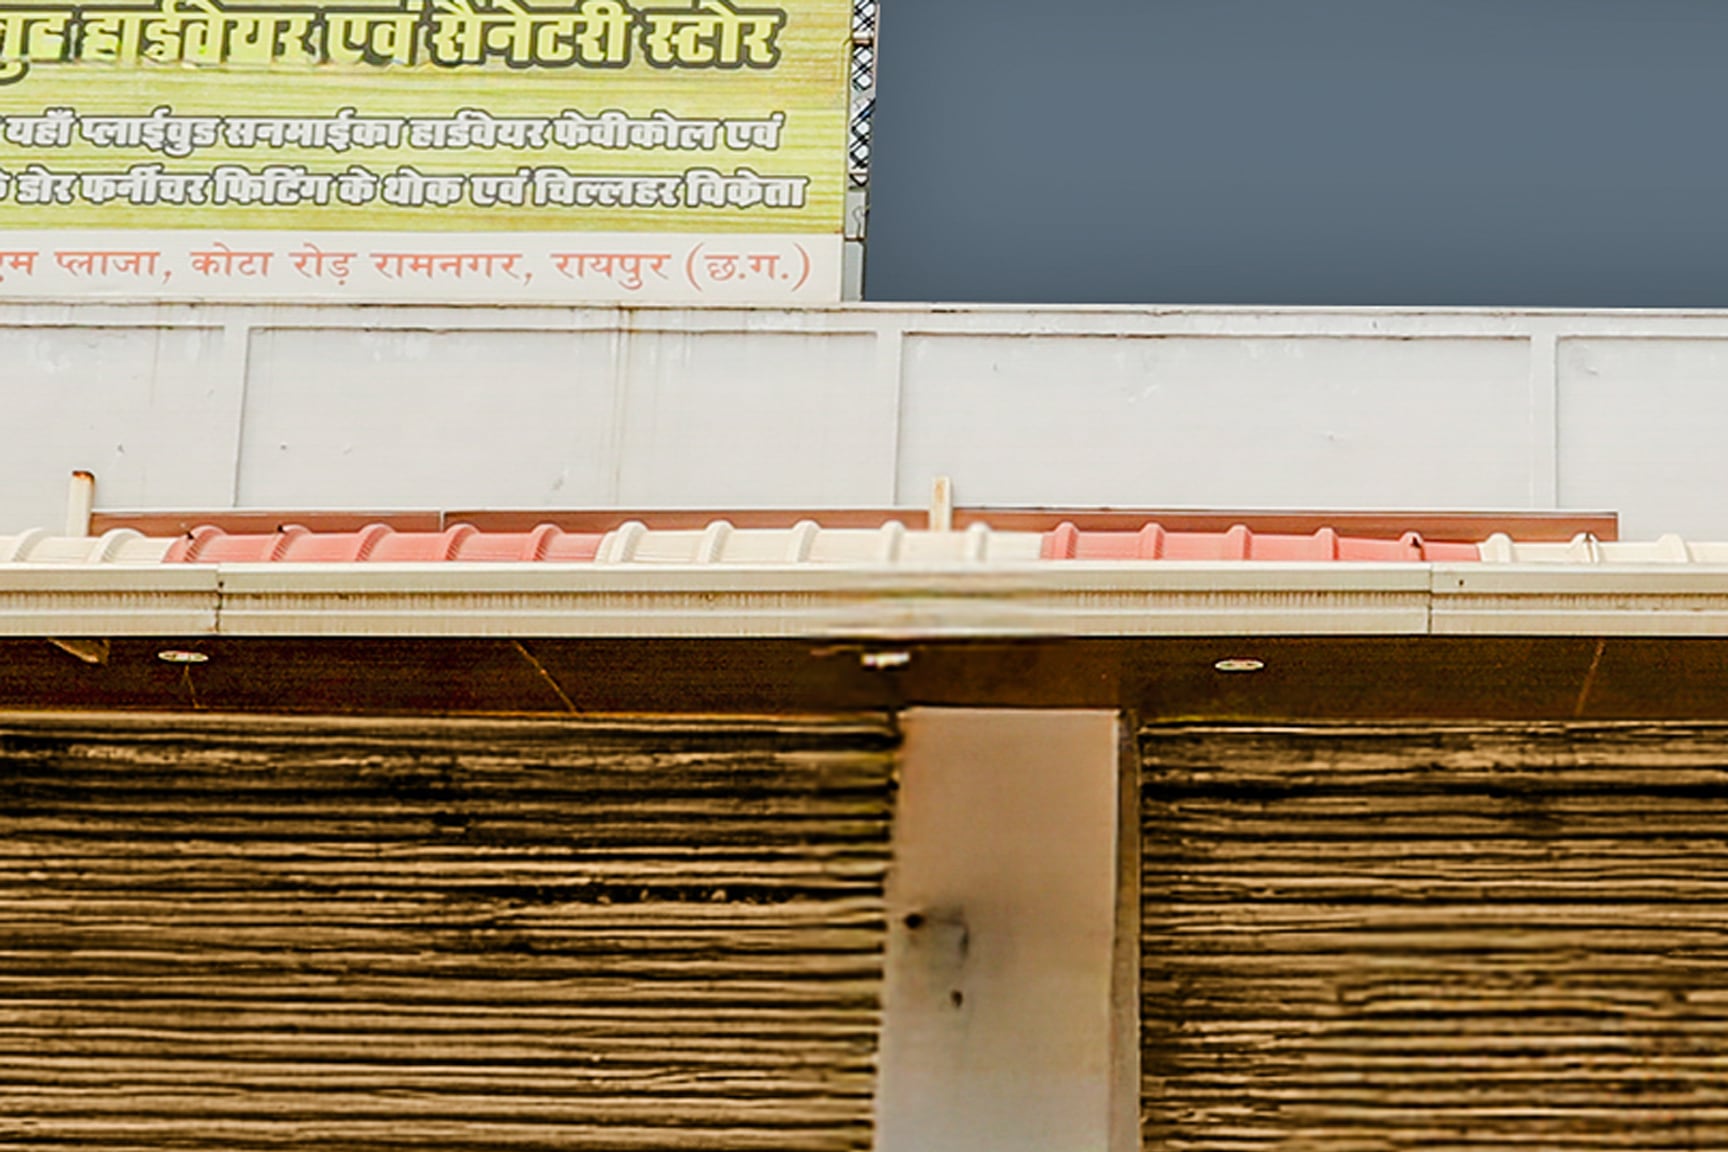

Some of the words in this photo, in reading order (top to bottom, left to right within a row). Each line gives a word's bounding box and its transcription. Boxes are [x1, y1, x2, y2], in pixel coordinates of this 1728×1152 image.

[640, 0, 787, 70] स्टोर
[3, 107, 78, 148] यहाँ
[80, 105, 222, 158] प्लाईवुड
[222, 107, 405, 153] सनमाईका
[552, 108, 721, 150] फेवीकोल
[722, 111, 786, 150] एवं
[15, 164, 78, 204] डोर
[336, 165, 380, 205] के
[381, 165, 467, 206] थोक
[469, 167, 532, 207] एवं
[54, 251, 171, 284] प्लाजा,
[190, 243, 273, 277] कोटा
[289, 243, 357, 286] रोड़
[370, 252, 533, 284] रामनगर,
[550, 253, 672, 291] रायपुर
[685, 242, 811, 292] (छ.ग.)
